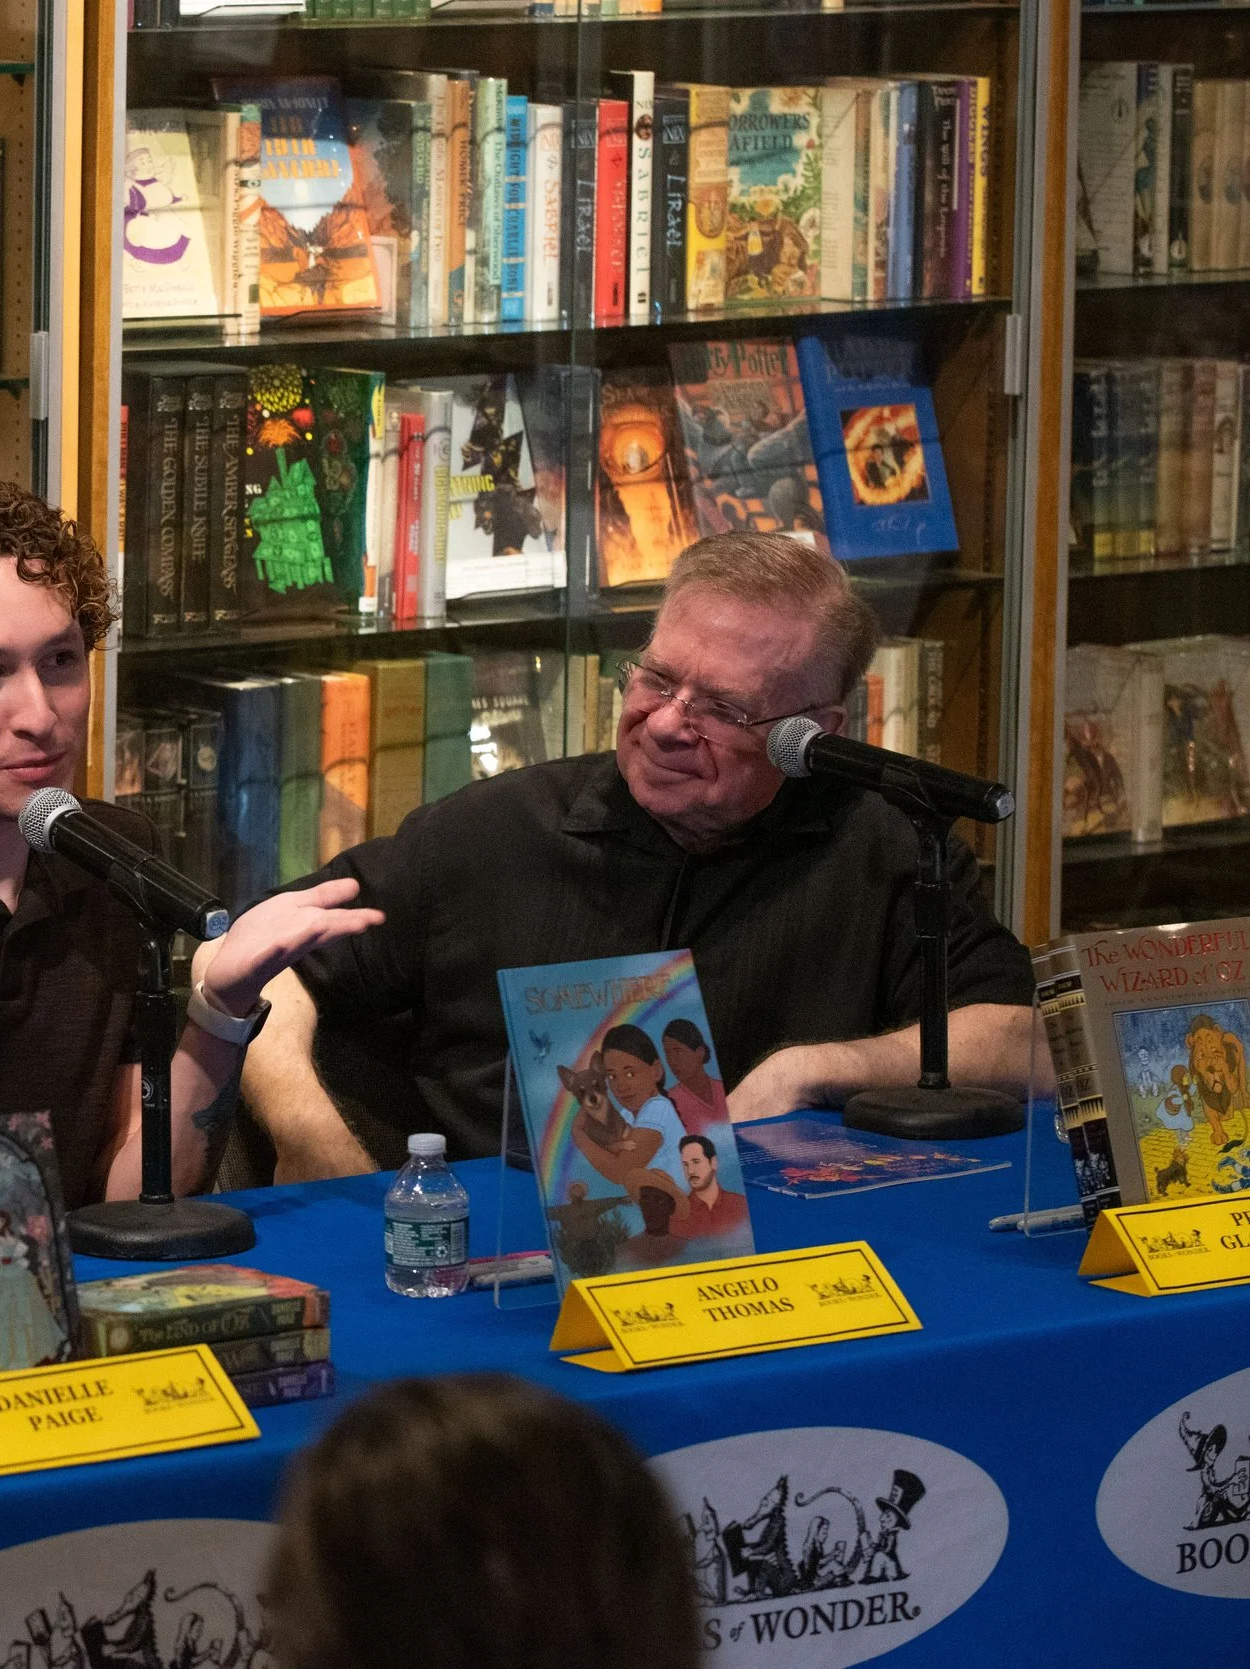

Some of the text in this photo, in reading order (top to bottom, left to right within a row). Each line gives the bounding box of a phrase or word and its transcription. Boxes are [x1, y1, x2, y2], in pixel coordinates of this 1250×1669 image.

[459, 140, 469, 188] HOMER
[729, 133, 794, 151] AFIELD
[492, 141, 503, 280] The Outlaws Sherwood
[636, 147, 652, 274] SABRIEL
[156, 417, 178, 599] THE GOLDEN COMPASS
[190, 416, 209, 561] THE SUBTLE KNIFE
[220, 414, 240, 595] THE AMBER SPYGLASS
[1081, 930, 1250, 967] The WONDERFUL
[1100, 960, 1246, 993] WIZARD of OZ
[697, 1276, 779, 1302] ANGELO
[702, 1297, 795, 1323] THOMAS
[28, 1406, 103, 1432] PAIGE
[729, 1591, 915, 1645] of WONDER
